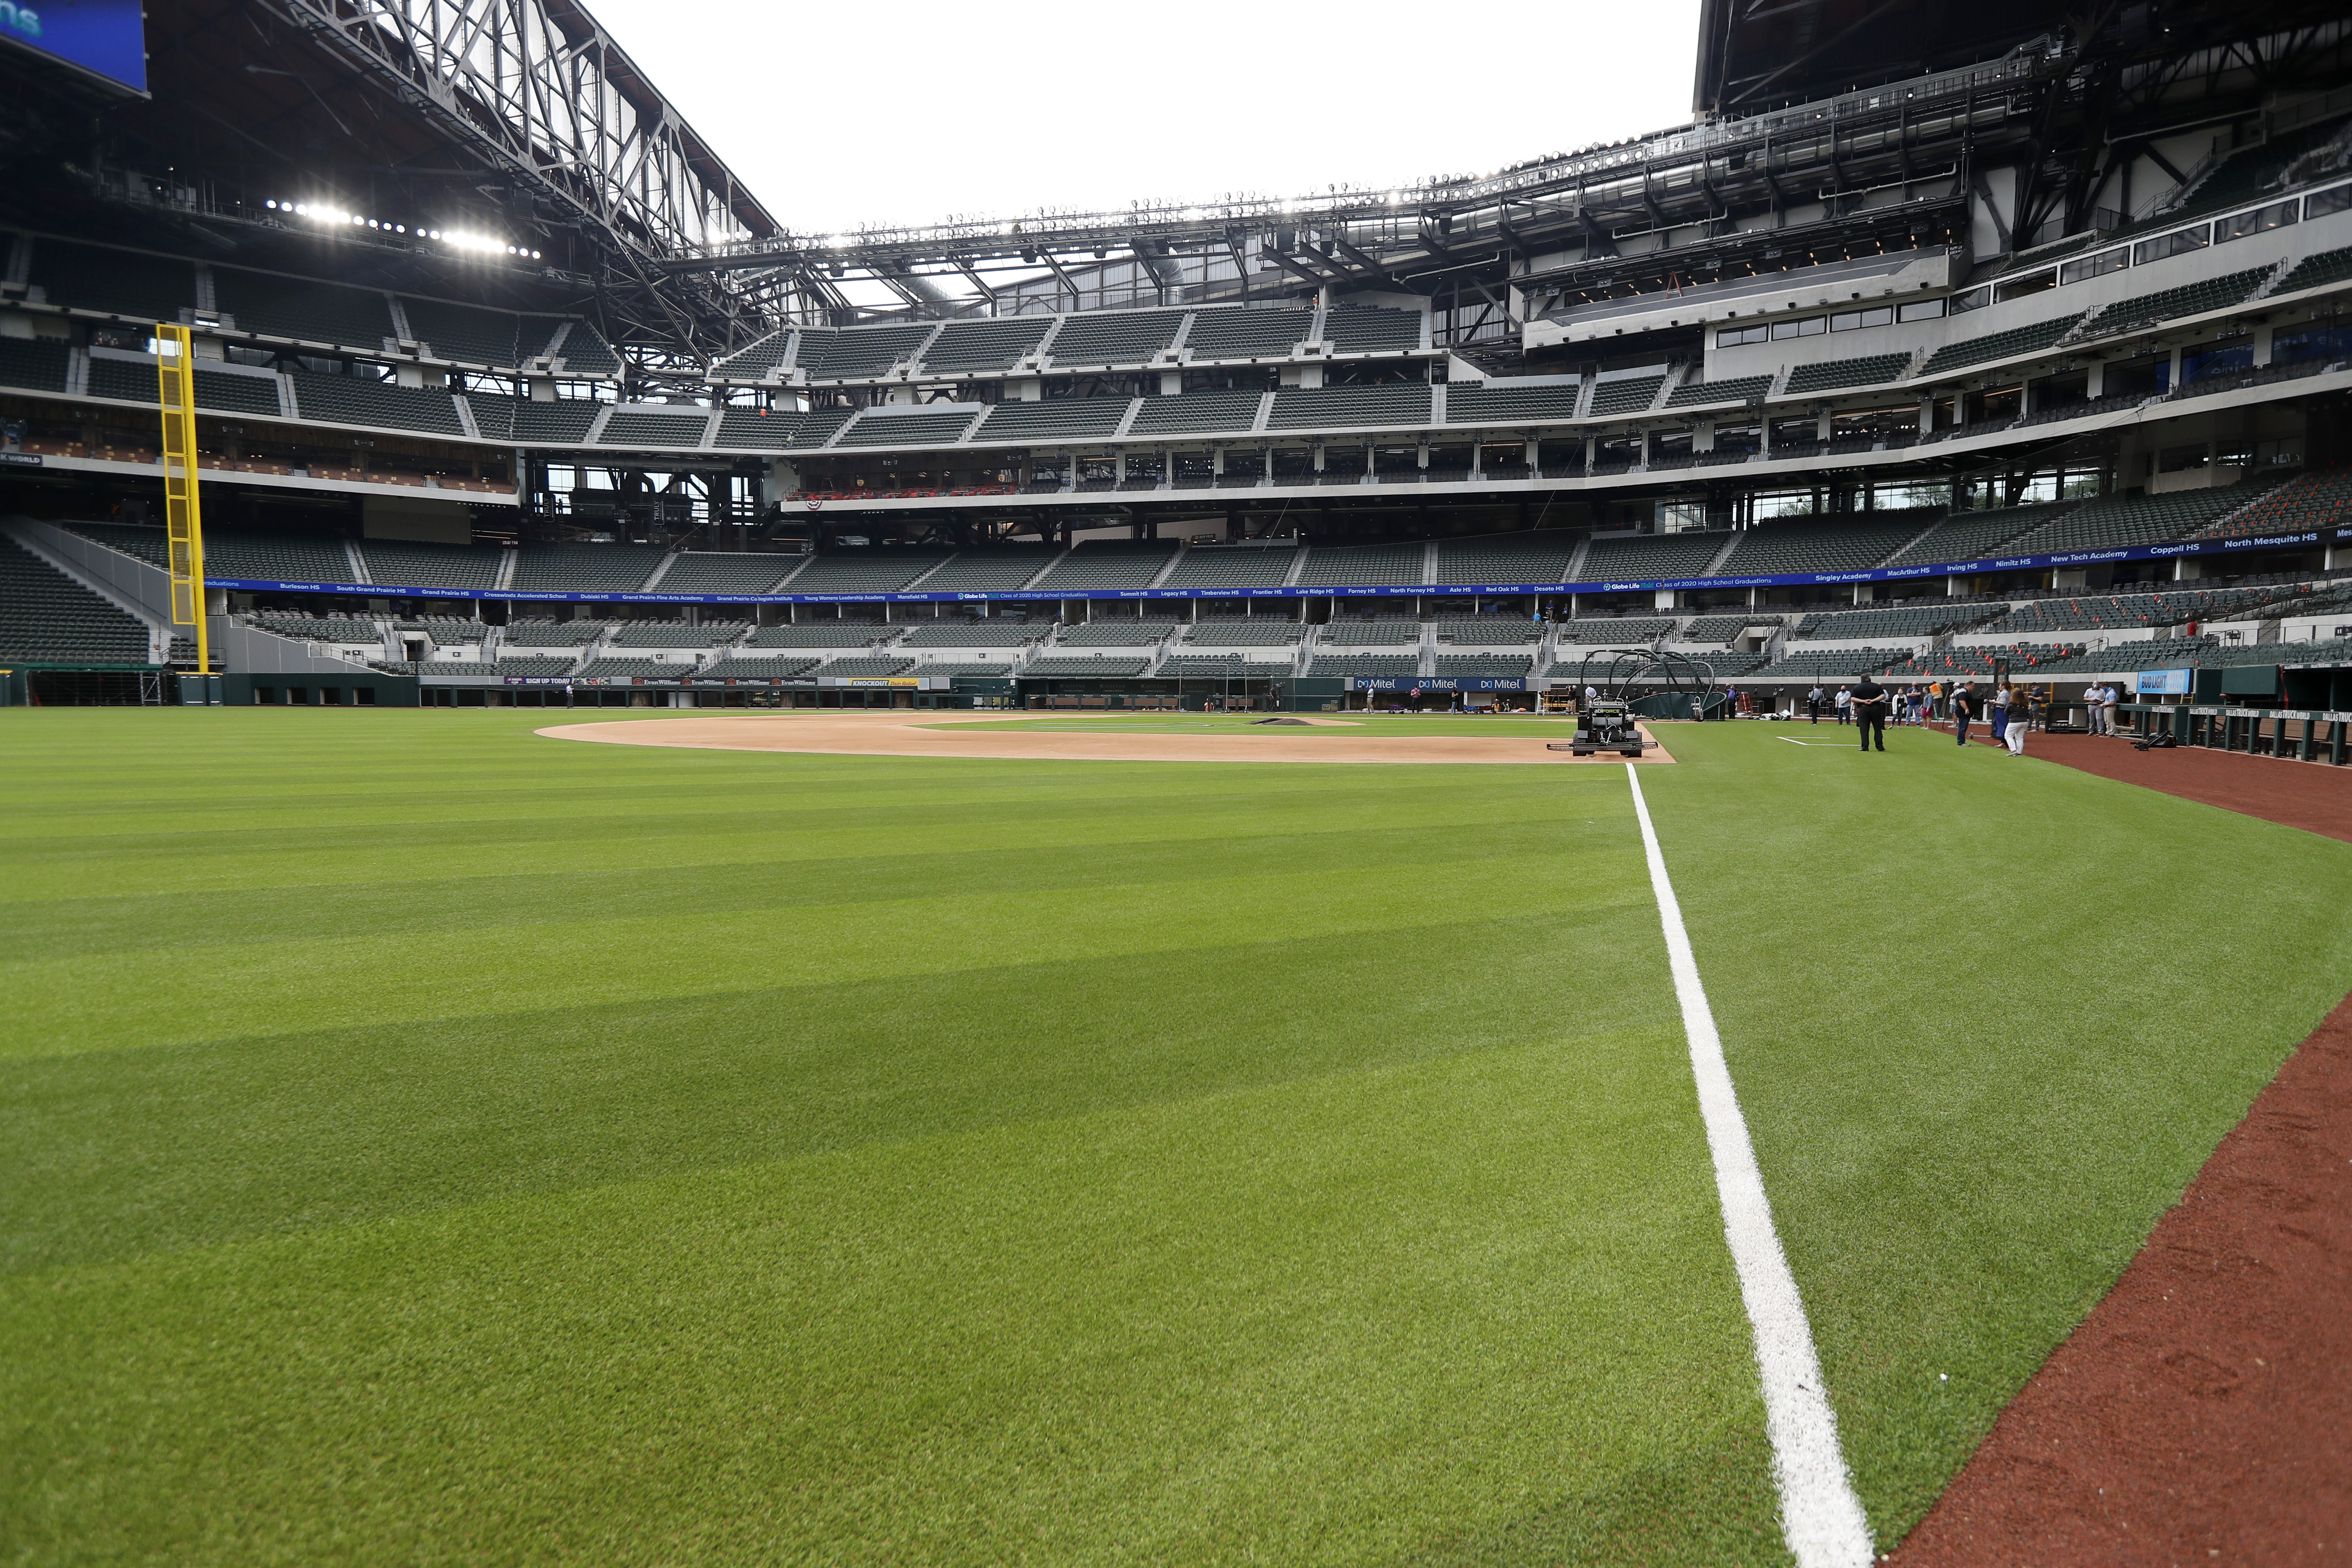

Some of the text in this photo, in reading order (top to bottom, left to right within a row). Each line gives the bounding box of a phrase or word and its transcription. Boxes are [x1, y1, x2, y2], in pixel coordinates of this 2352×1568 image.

[2254, 536, 2299, 545] Mesquite
[2151, 545, 2184, 554] Coppell
[1370, 680, 1394, 688] Mitel
[1432, 680, 1457, 689] Mitel
[1494, 680, 1520, 689] Mitel
[2141, 676, 2152, 689] BUD
[2152, 675, 2167, 689] LIGHT
[2282, 710, 2297, 719] TRUCK
[2322, 713, 2338, 721] DALLAS
